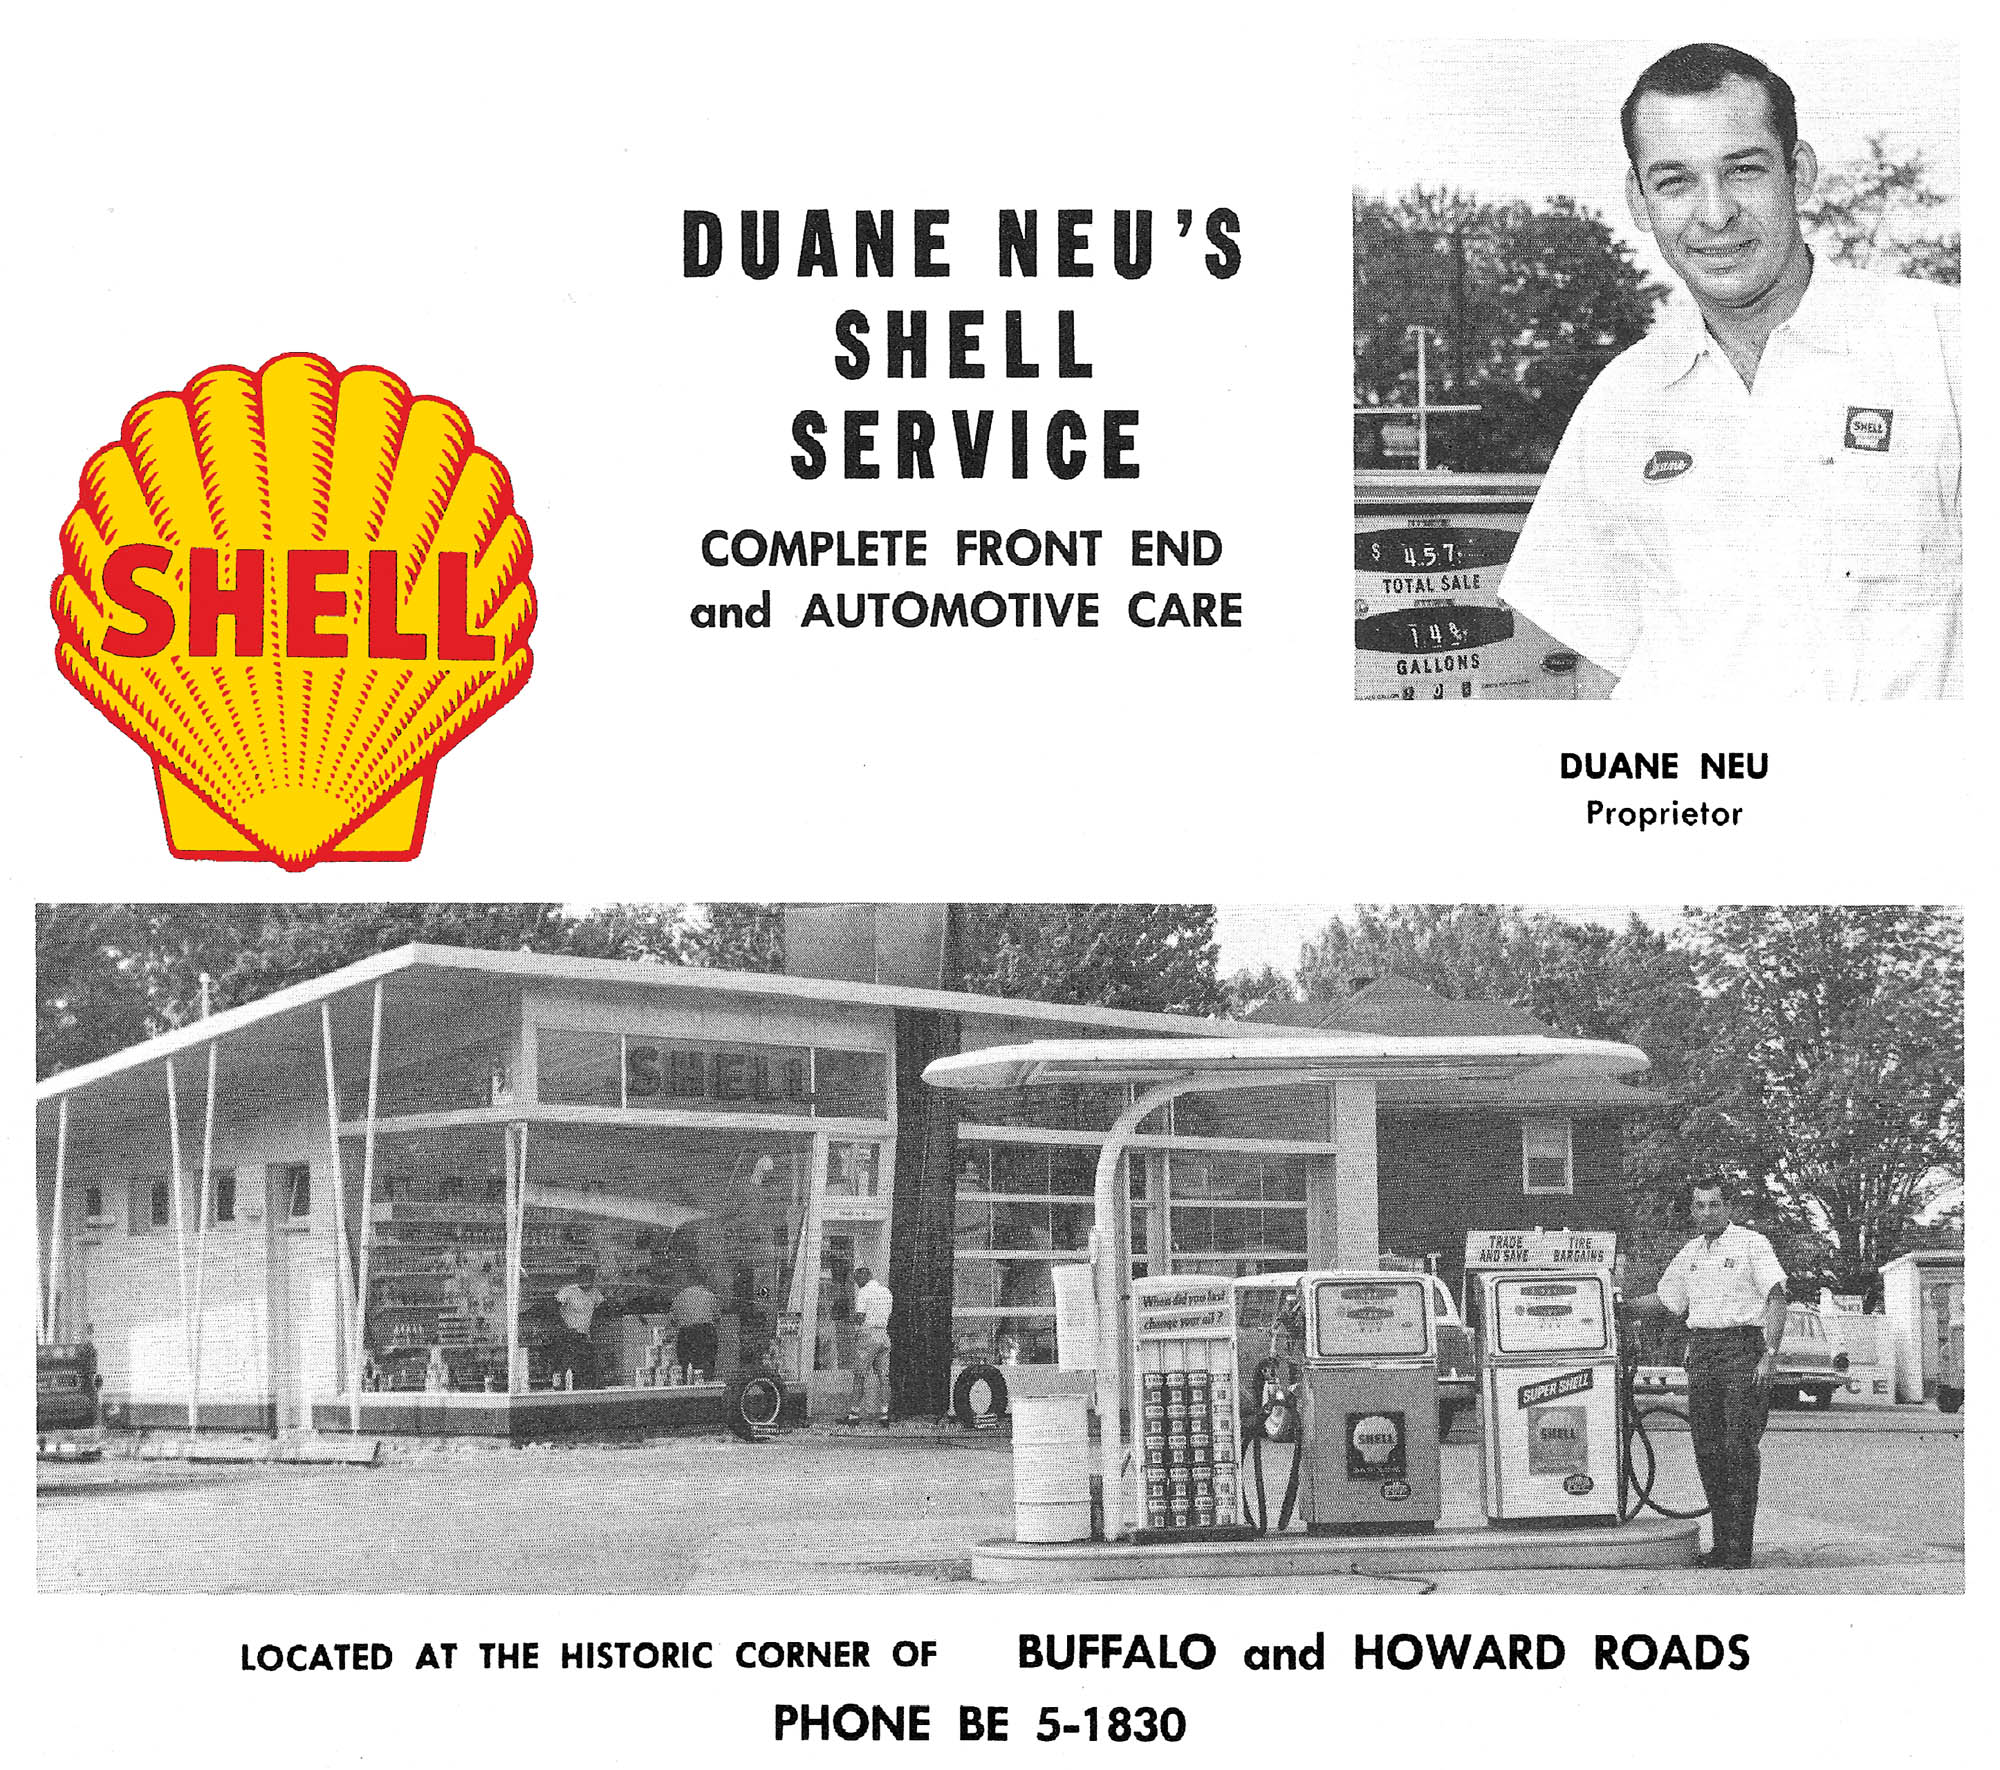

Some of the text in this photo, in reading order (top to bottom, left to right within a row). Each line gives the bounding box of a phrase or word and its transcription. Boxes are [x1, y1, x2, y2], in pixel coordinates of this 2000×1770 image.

[1853, 420, 1883, 434] SHELL
[1383, 574, 1480, 594] TOTAL SALE
[101, 543, 496, 661] SHELL
[1397, 654, 1480, 675] GALLONS
[627, 1045, 814, 1104] SHELL
[1489, 1235, 1523, 1249] TRADE
[1569, 1237, 1592, 1249] TIRE
[1479, 1249, 1529, 1262] AND SAVE
[1553, 1250, 1604, 1263] BARGAINS
[1143, 1289, 1225, 1307] When did you last
[1144, 1316, 1178, 1330] change
[1180, 1315, 1200, 1328] your
[1522, 1372, 1589, 1404] SUPER SHELL
[1358, 1433, 1396, 1445] SHELL
[1540, 1427, 1577, 1440] SHELL
